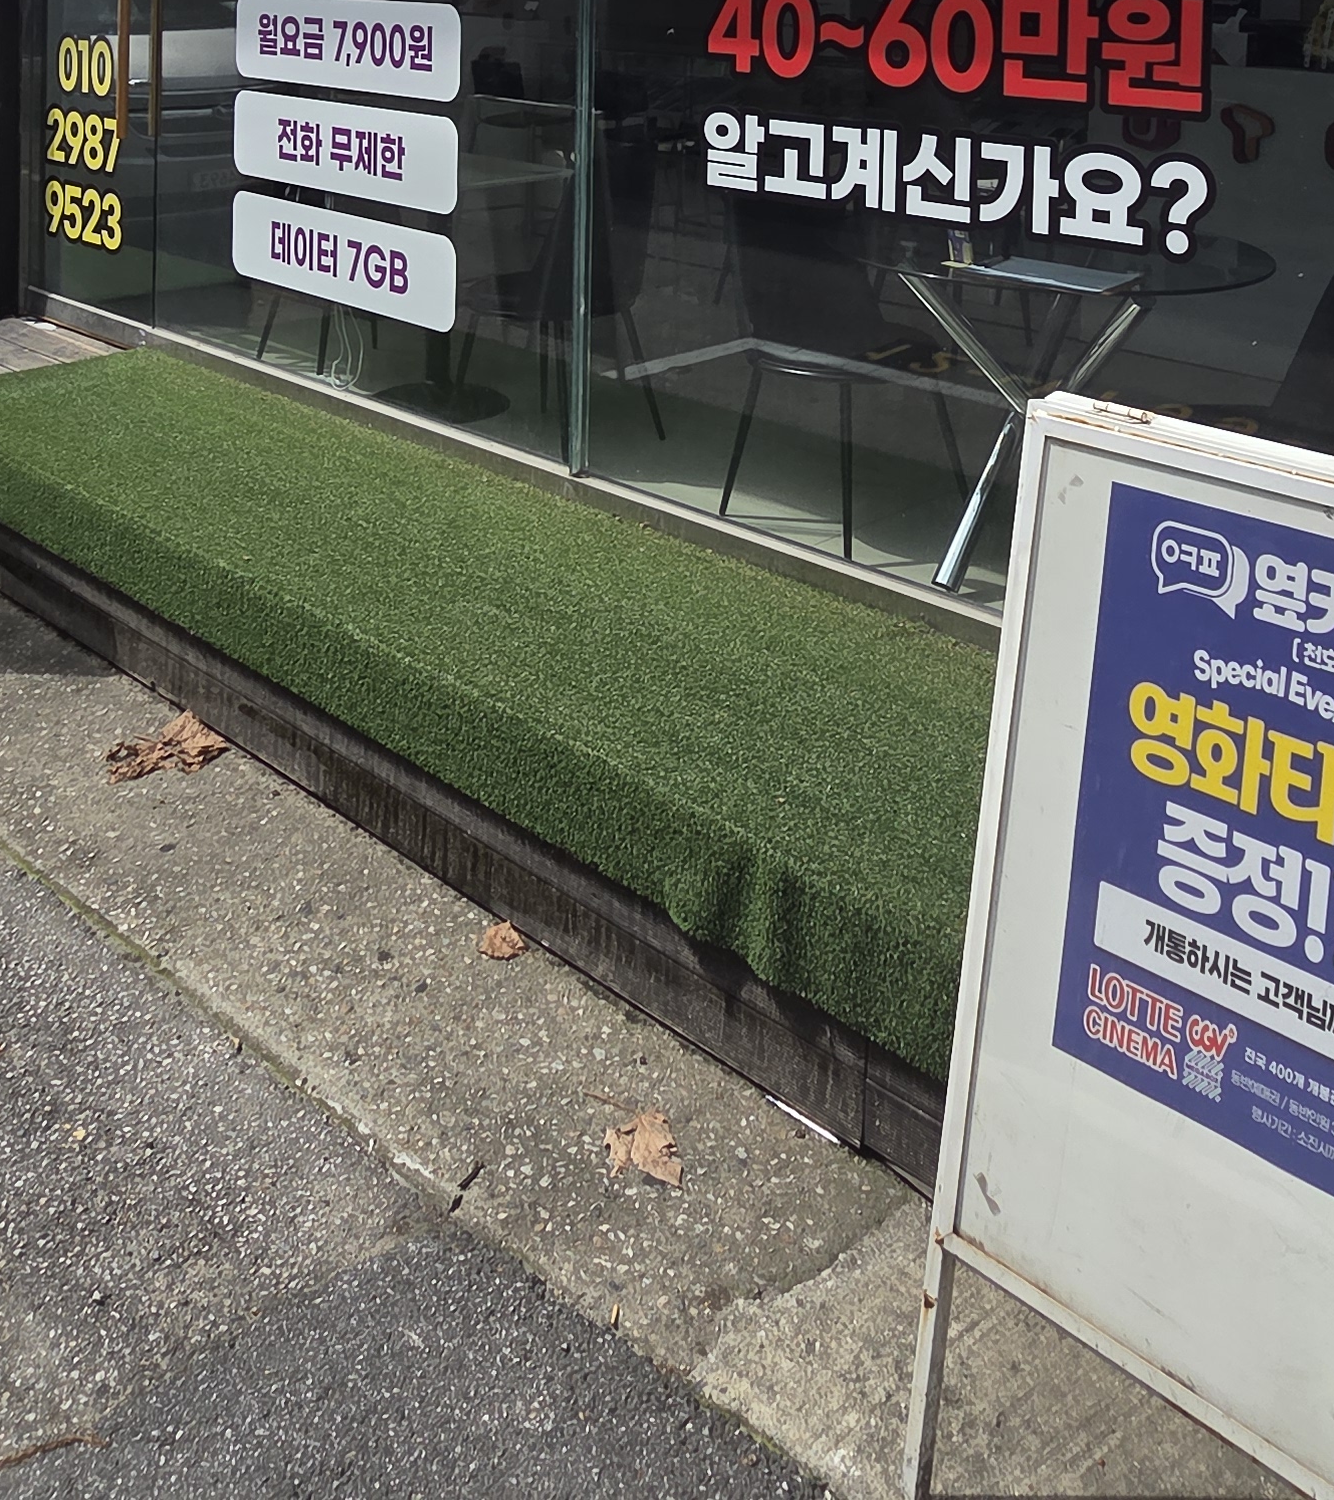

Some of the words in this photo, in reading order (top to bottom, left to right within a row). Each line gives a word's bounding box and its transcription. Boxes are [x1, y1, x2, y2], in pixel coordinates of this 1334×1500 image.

[58, 35, 112, 97] 010
[257, 13, 325, 62] 월요금
[333, 19, 434, 73] 7,900원
[45, 107, 121, 174] 2987
[277, 118, 323, 164] 전화
[329, 129, 406, 182] 무제한
[45, 181, 122, 251] 9523
[703, 110, 1210, 258] 알고계신가요?
[269, 220, 339, 279] 데이터
[347, 239, 409, 295] 7GB
[1193, 648, 1286, 699] Special
[1144, 918, 1253, 997] 개통하시는
[1087, 963, 1184, 1043] LOTTE
[1083, 1005, 1178, 1080] CINEMA
[1185, 1014, 1233, 1062] CGV
[1244, 1046, 1267, 1071] 전국
[1268, 1060, 1305, 1090] 400개
